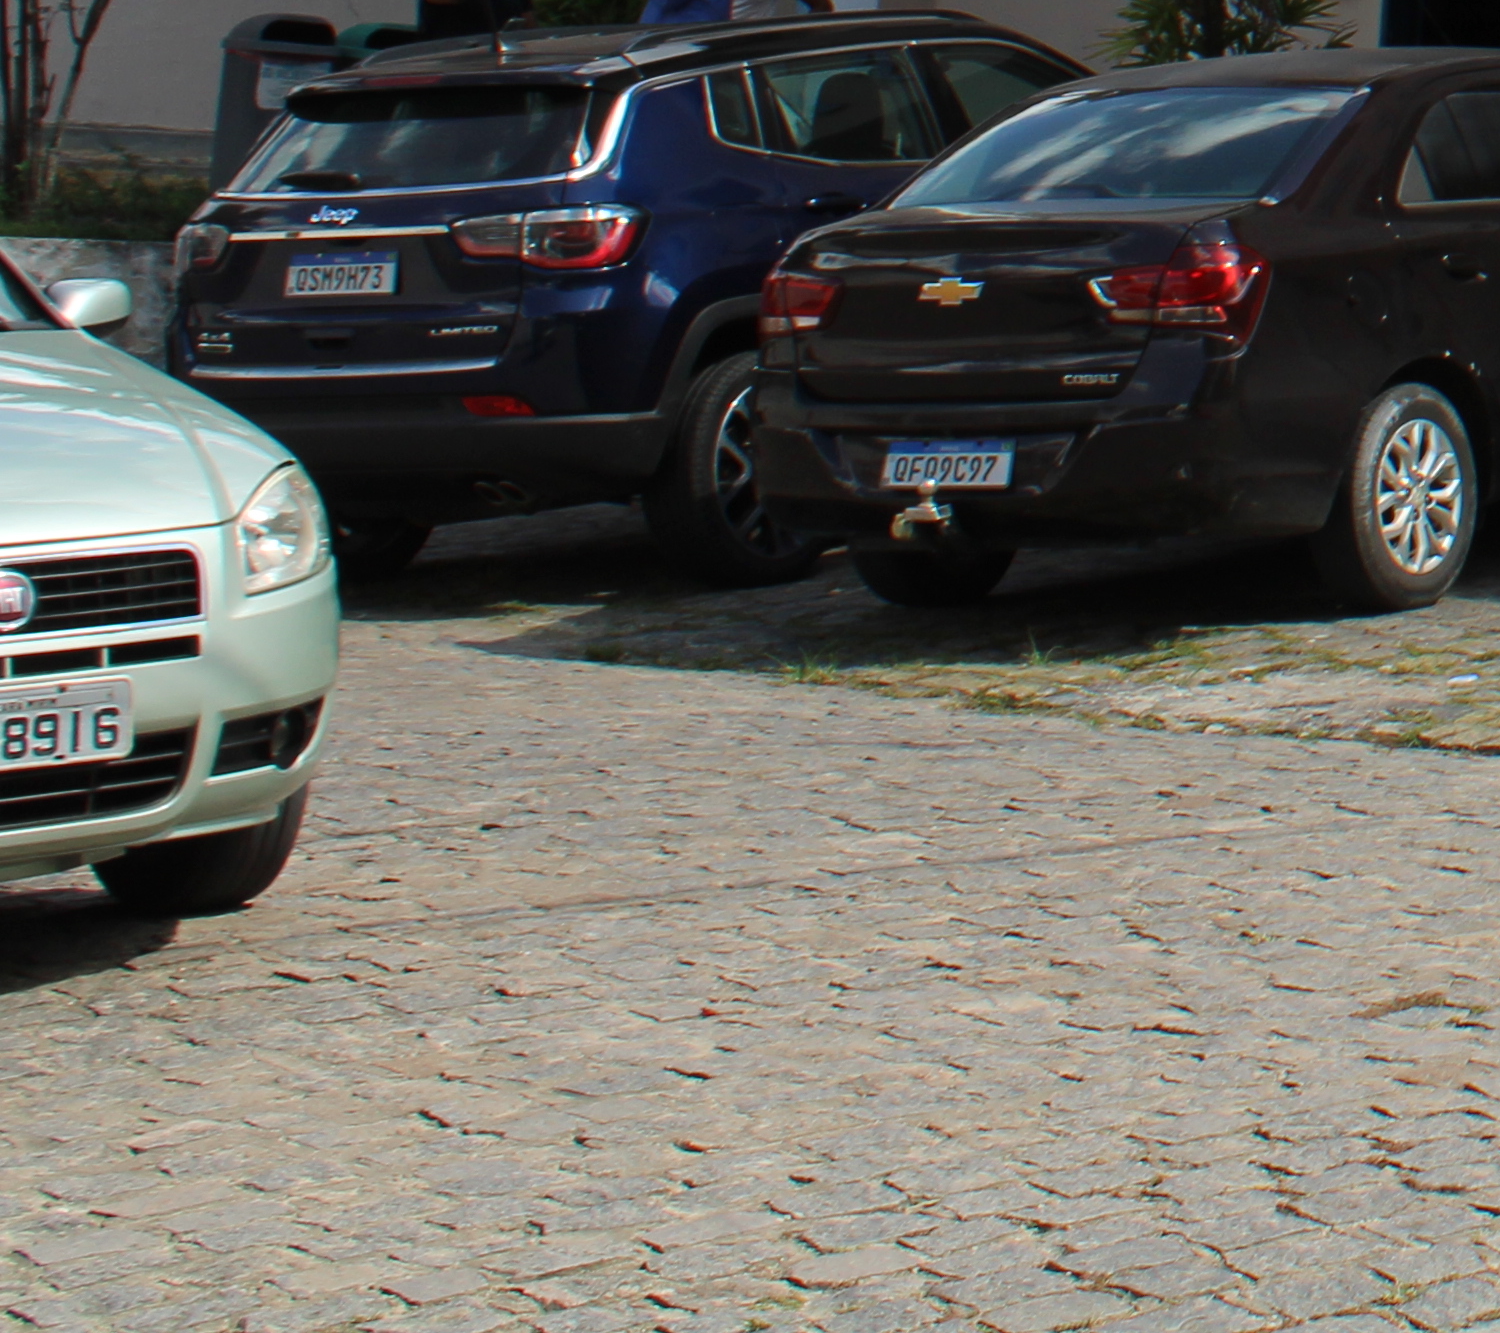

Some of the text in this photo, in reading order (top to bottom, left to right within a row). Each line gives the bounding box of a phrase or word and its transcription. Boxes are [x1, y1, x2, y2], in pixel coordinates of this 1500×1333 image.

[309, 205, 359, 225] Jeep
[294, 265, 383, 293] QSM9H73
[893, 455, 999, 483] QFQ9C97
[3, 705, 120, 760] 8916
